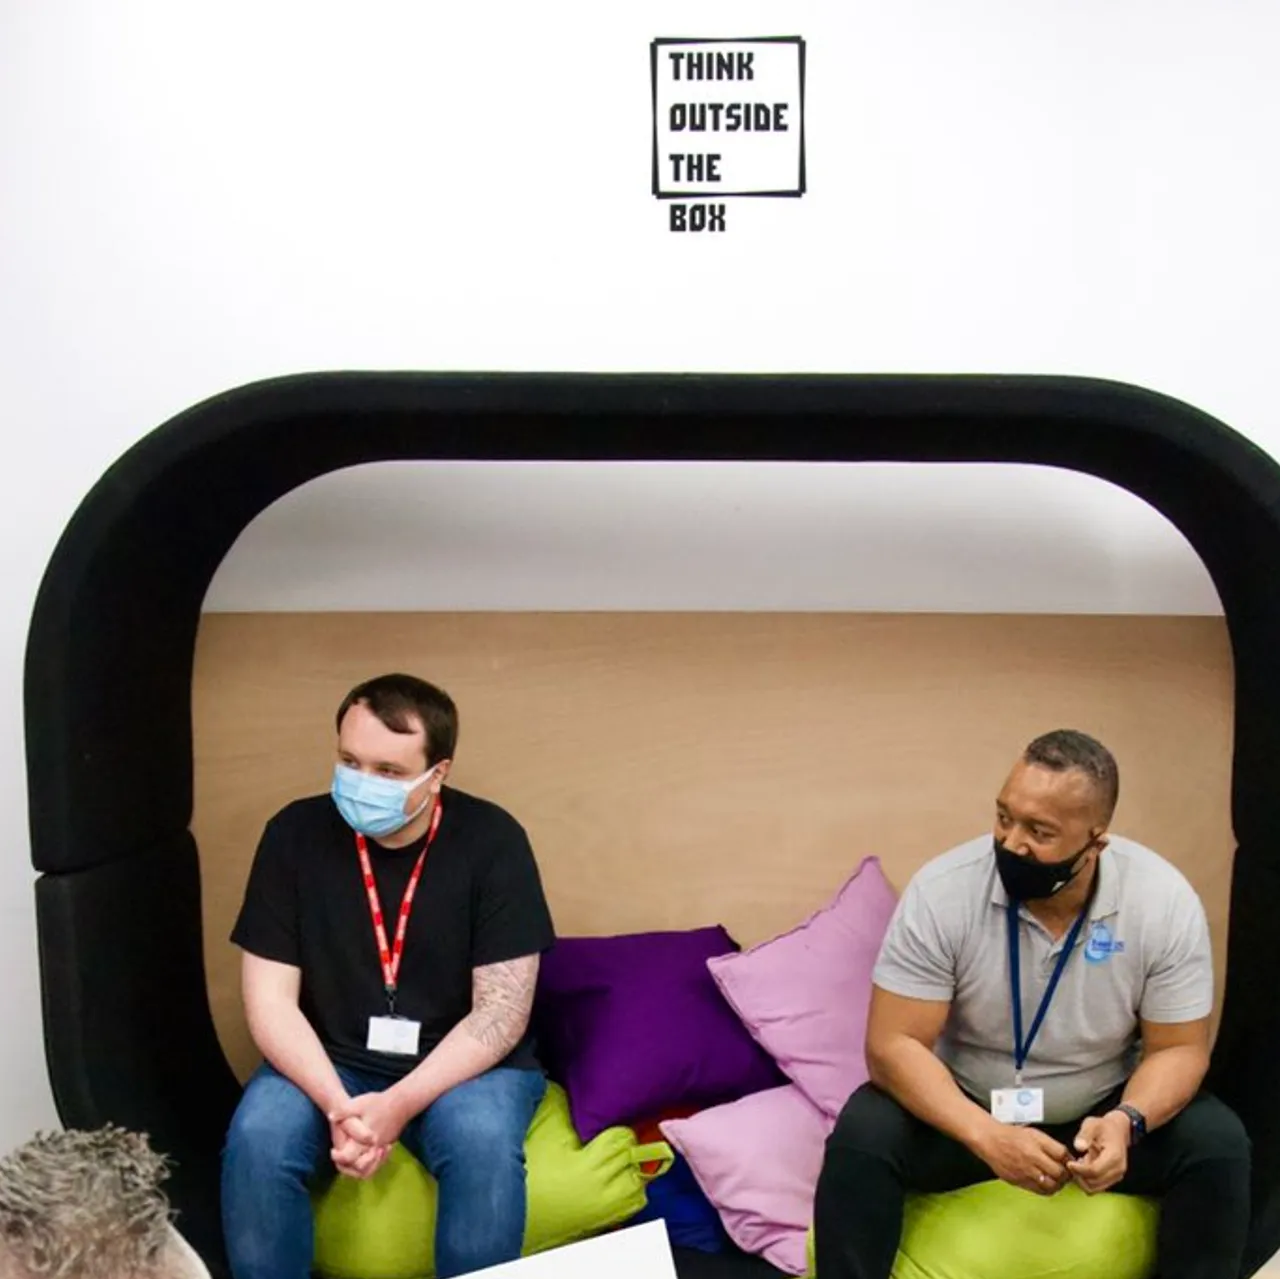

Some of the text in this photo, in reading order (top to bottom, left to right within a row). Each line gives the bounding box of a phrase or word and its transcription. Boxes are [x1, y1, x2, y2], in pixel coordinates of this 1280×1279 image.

[669, 52, 754, 80] THINK
[669, 103, 789, 131] OUTSIDE
[669, 154, 722, 182] THE
[669, 204, 726, 232] BOX
